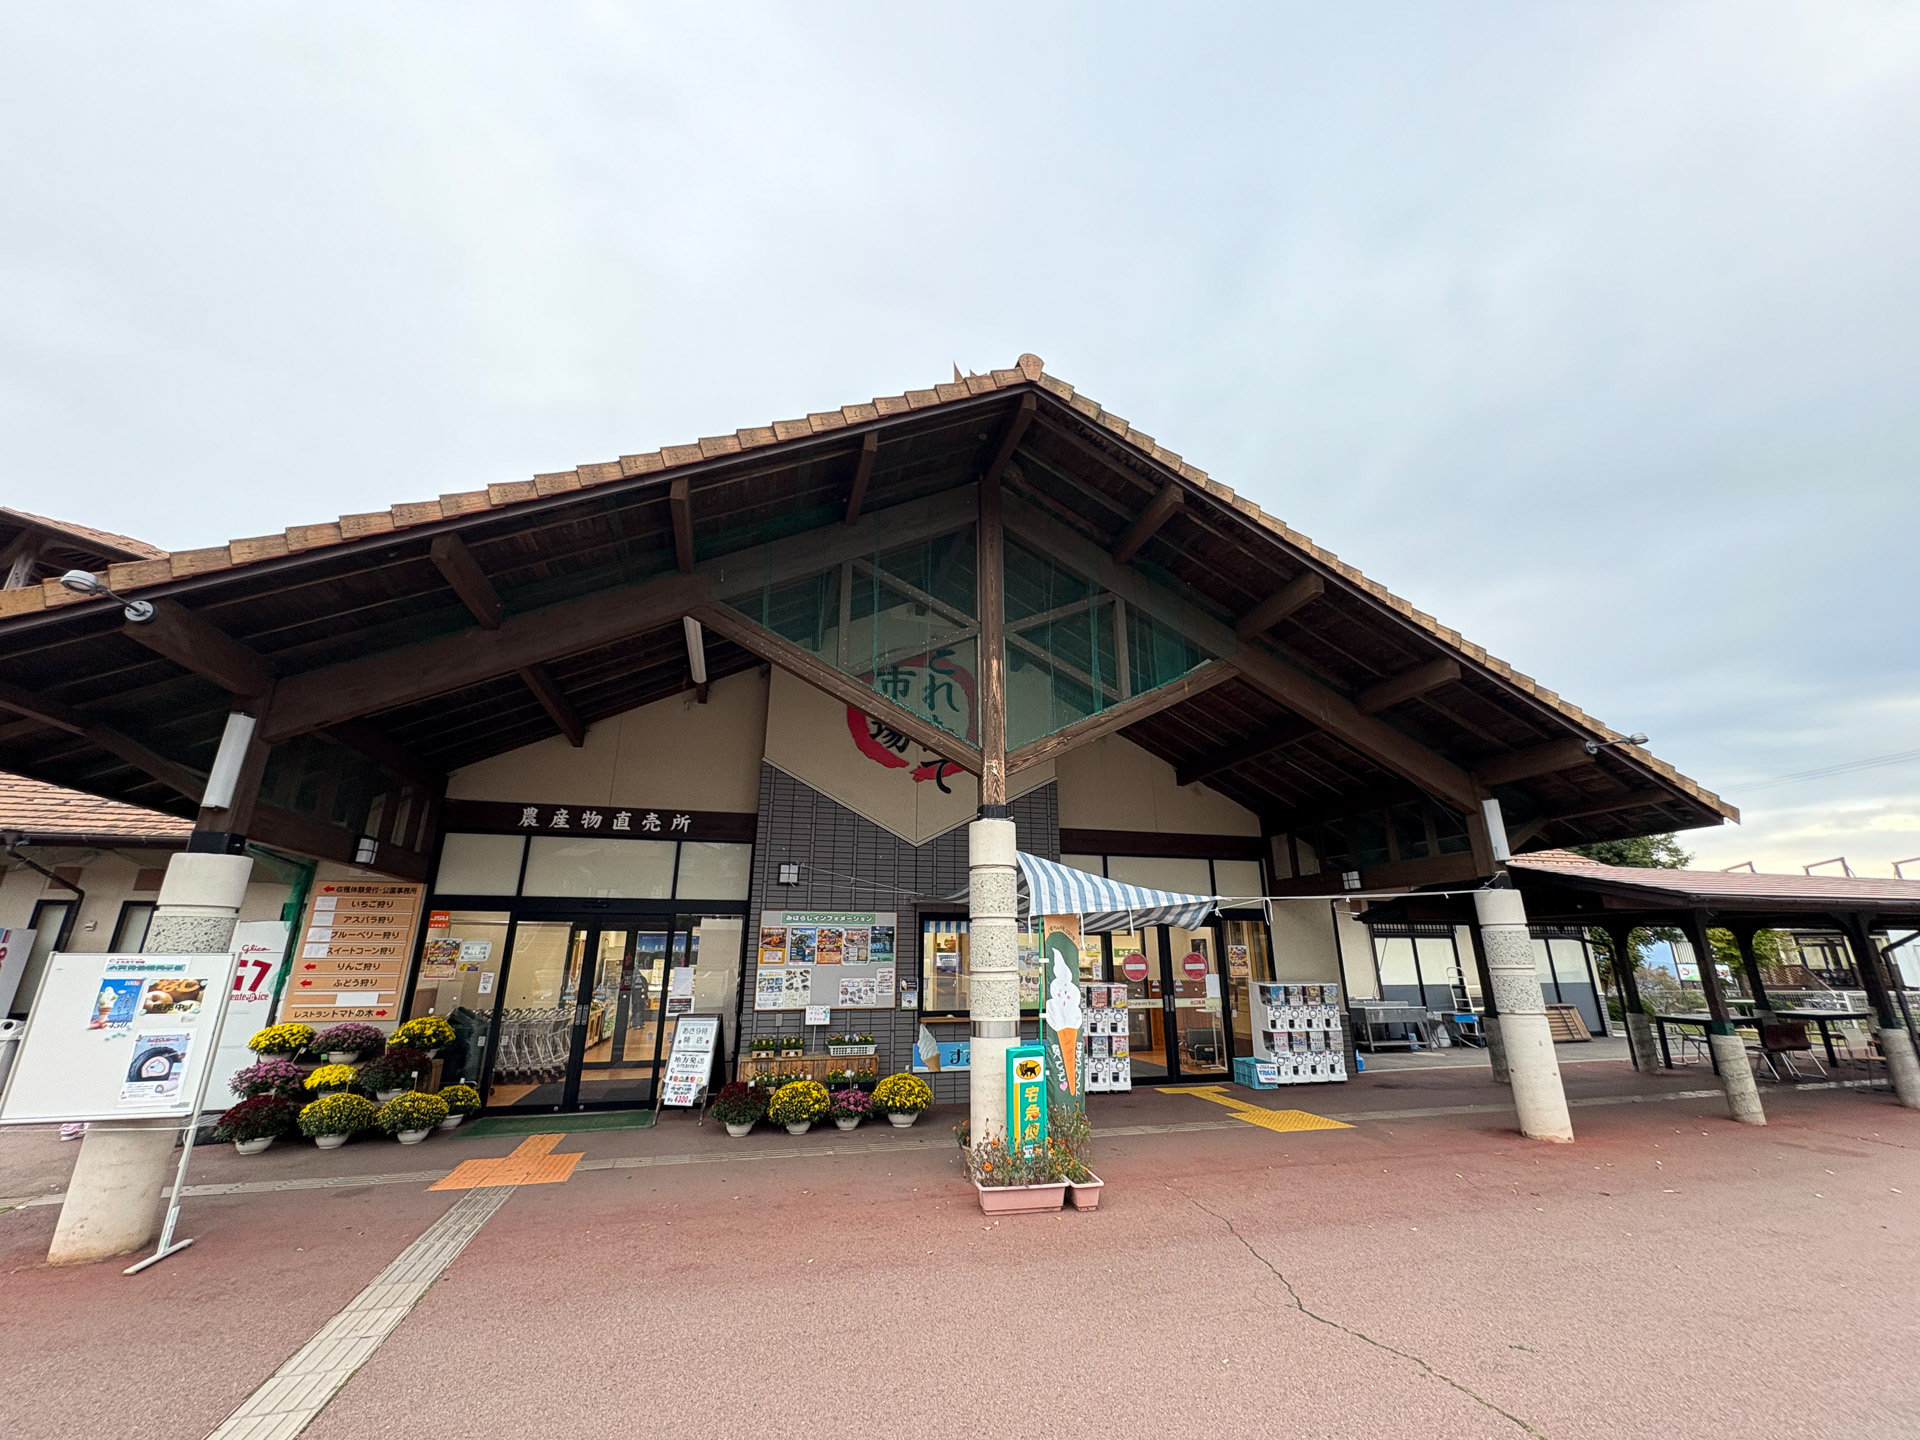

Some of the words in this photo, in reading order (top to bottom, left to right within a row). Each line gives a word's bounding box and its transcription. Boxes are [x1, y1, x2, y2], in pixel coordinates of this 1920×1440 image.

[922, 648, 960, 794] とれて
[517, 806, 692, 833] 農産物直売所
[351, 900, 394, 908] いちご狩り
[343, 916, 395, 924] アスパラ狩り
[785, 914, 873, 922] みはらしインフォメーション
[337, 963, 381, 971] りんご狩り
[1024, 1085, 1041, 1141] 宅急便
